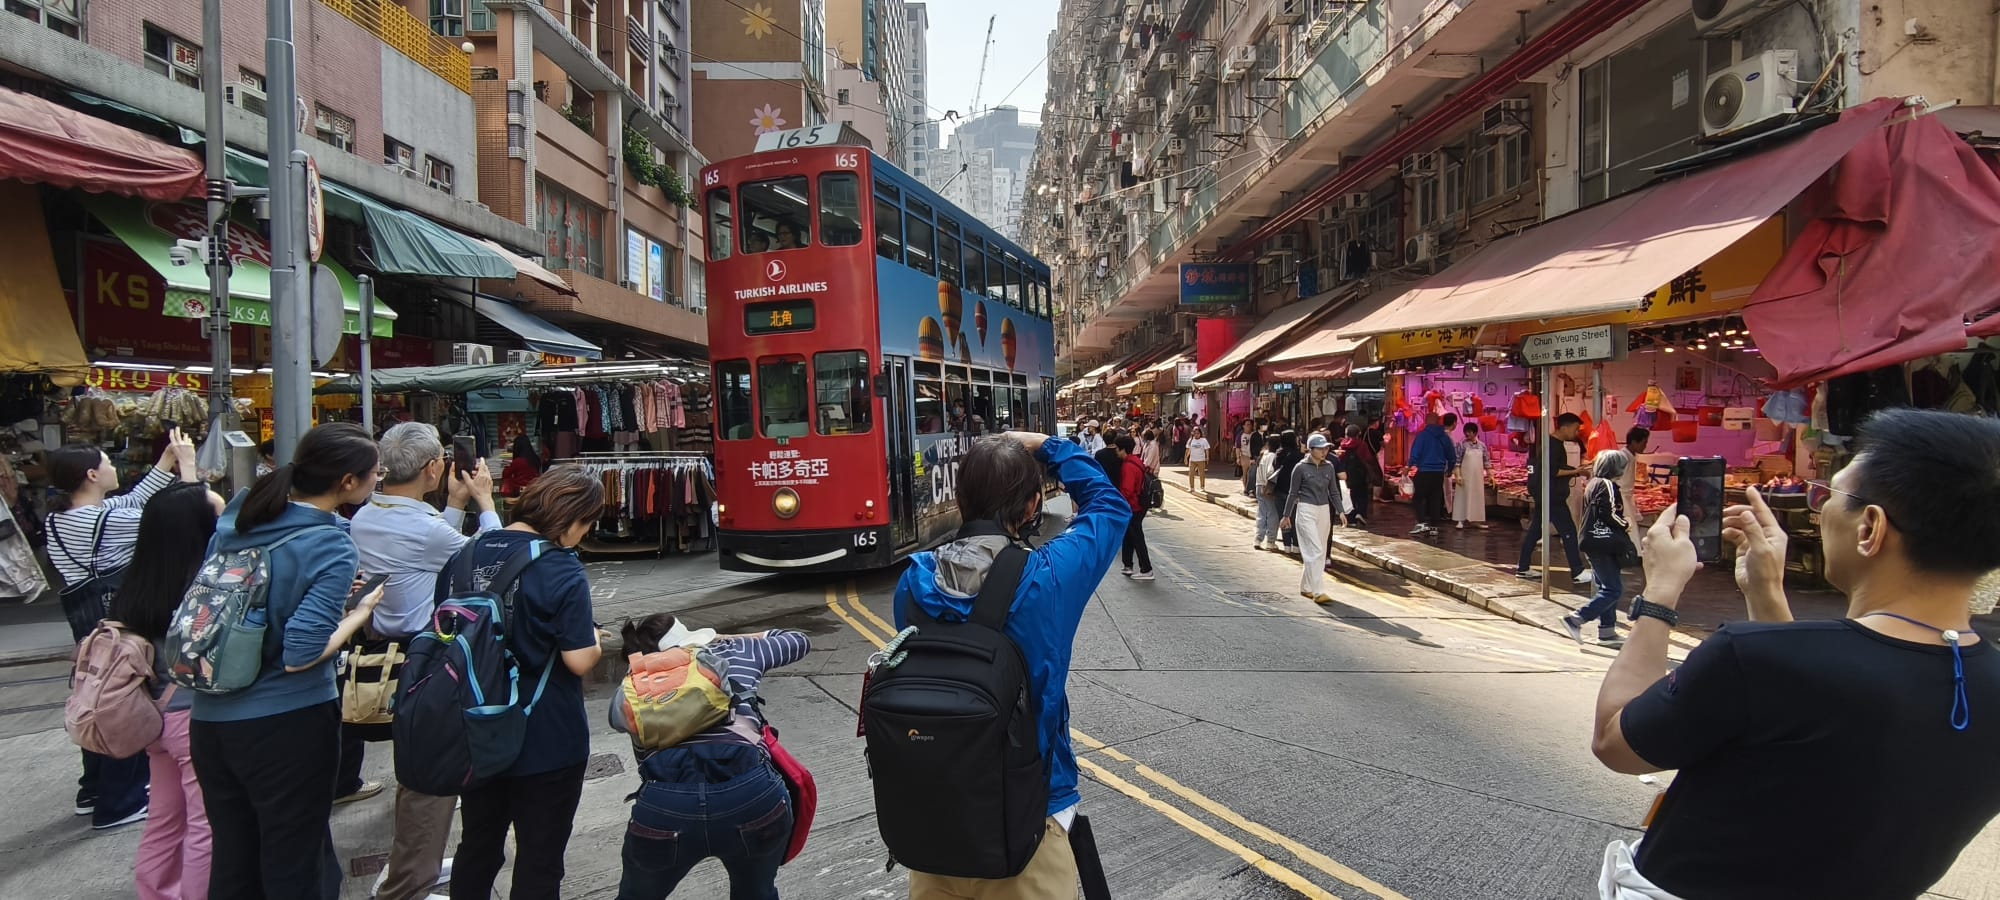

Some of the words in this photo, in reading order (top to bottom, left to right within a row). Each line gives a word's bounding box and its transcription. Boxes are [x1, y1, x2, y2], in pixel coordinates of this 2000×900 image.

[777, 127, 823, 149] 165
[835, 153, 858, 168] 165
[705, 170, 719, 186] 165
[97, 268, 149, 309] KS
[735, 286, 776, 300] TURKISH
[778, 281, 828, 295] AIRLINES
[770, 310, 792, 327] 北角
[1533, 337, 1553, 346] Chun
[1555, 333, 1579, 344] Yeung
[1581, 329, 1608, 341] Street
[1553, 346, 1588, 360] 春秧街
[167, 372, 201, 391] KS
[936, 438, 958, 459] WE'RE
[747, 458, 829, 480] 卡帕多奇亞
[853, 531, 877, 547] 165
